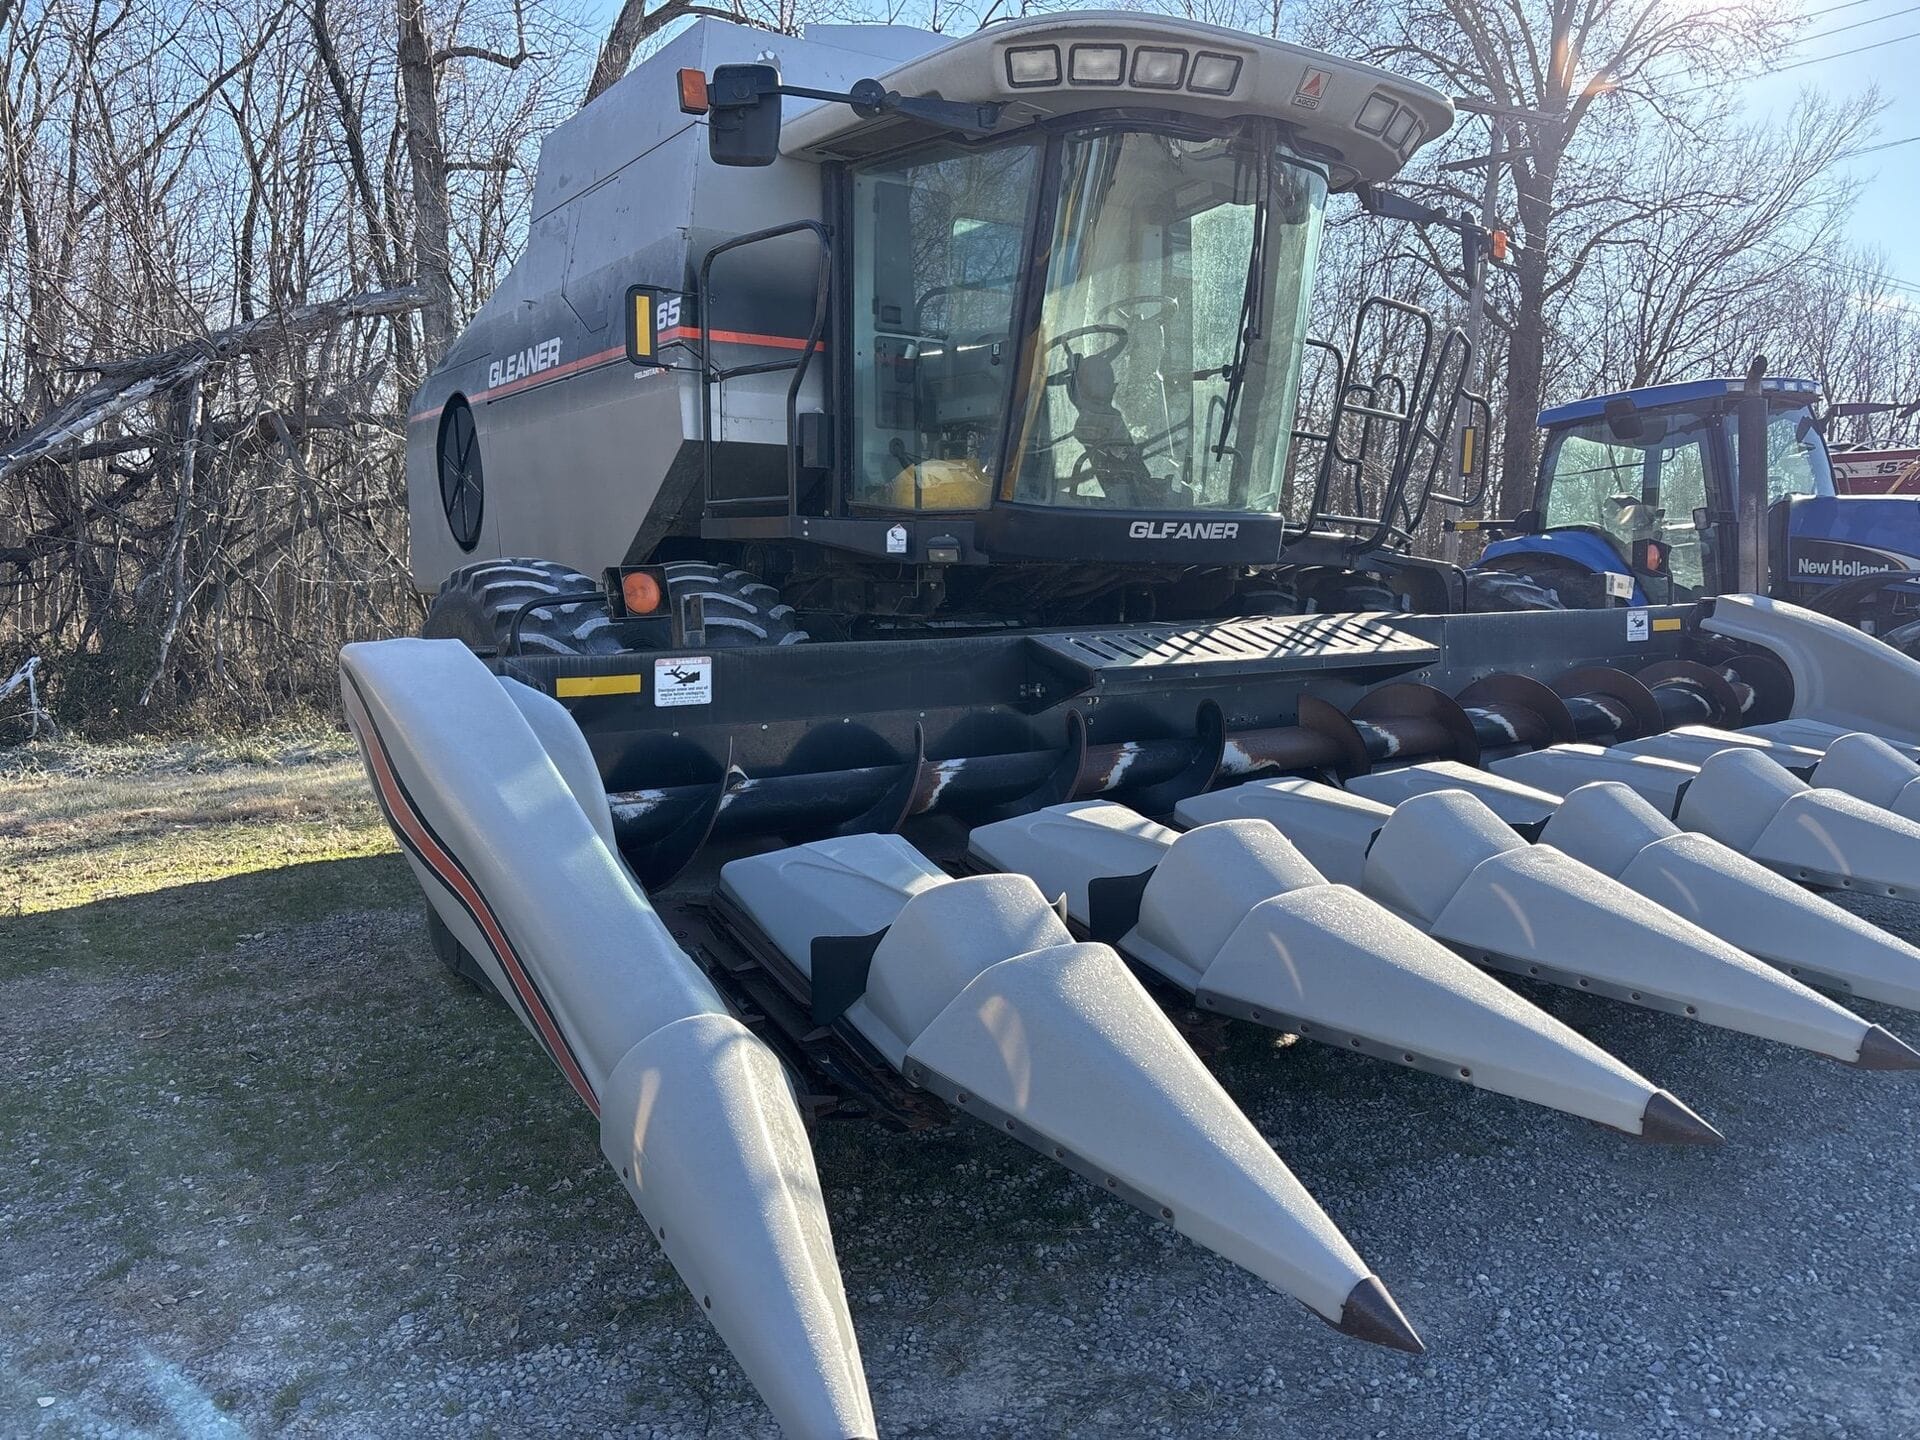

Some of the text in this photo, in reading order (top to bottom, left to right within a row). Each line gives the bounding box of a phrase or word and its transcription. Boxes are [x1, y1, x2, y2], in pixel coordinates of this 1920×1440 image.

[657, 297, 681, 330] 65
[489, 337, 561, 389] GLEANER
[1799, 559, 1830, 574] New
